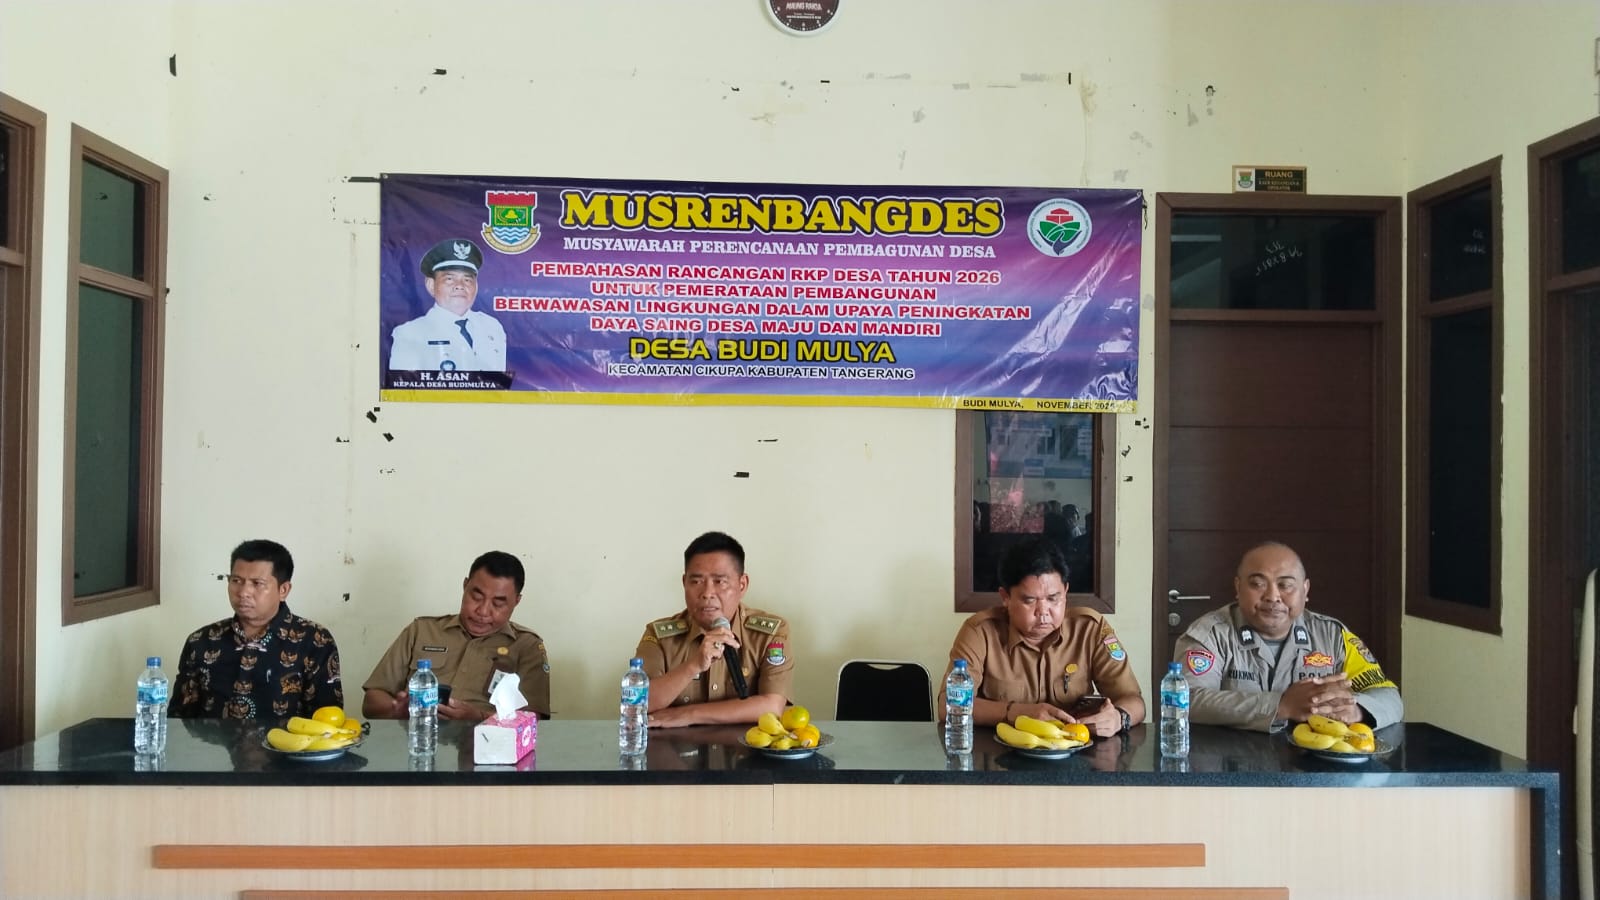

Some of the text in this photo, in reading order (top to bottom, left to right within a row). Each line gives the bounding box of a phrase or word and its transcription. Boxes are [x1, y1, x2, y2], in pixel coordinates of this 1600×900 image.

[562, 191, 1004, 236] MUSRENBANGDES
[563, 237, 996, 258] MUSYAWARAH PERENCANAAN PEMBAGUNAN DESA
[531, 263, 1001, 284] PEMBAHASAN RANCANGAN RKP DESA TAHUN 2026
[591, 282, 936, 300] UNTUK PEMERATAAN PEMBANGUNAN
[494, 298, 1030, 319] BERWAWASAN LINGKUNGAN DALAM UPAYA PENINGKATAN
[591, 317, 941, 336] DAYA SAING DESA MAJU DAN MANDIRI
[629, 337, 896, 363] DESA BUDI MULYA
[420, 372, 470, 381] H. ASAN
[608, 364, 914, 379] KECAMATAN CIKUPA KABUPATEN TANGERANG
[448, 381, 497, 389] BUDIMULYA
[963, 399, 986, 407] BUDI
[988, 400, 1024, 409] MULYA,
[1036, 400, 1092, 409] NOVEMBER
